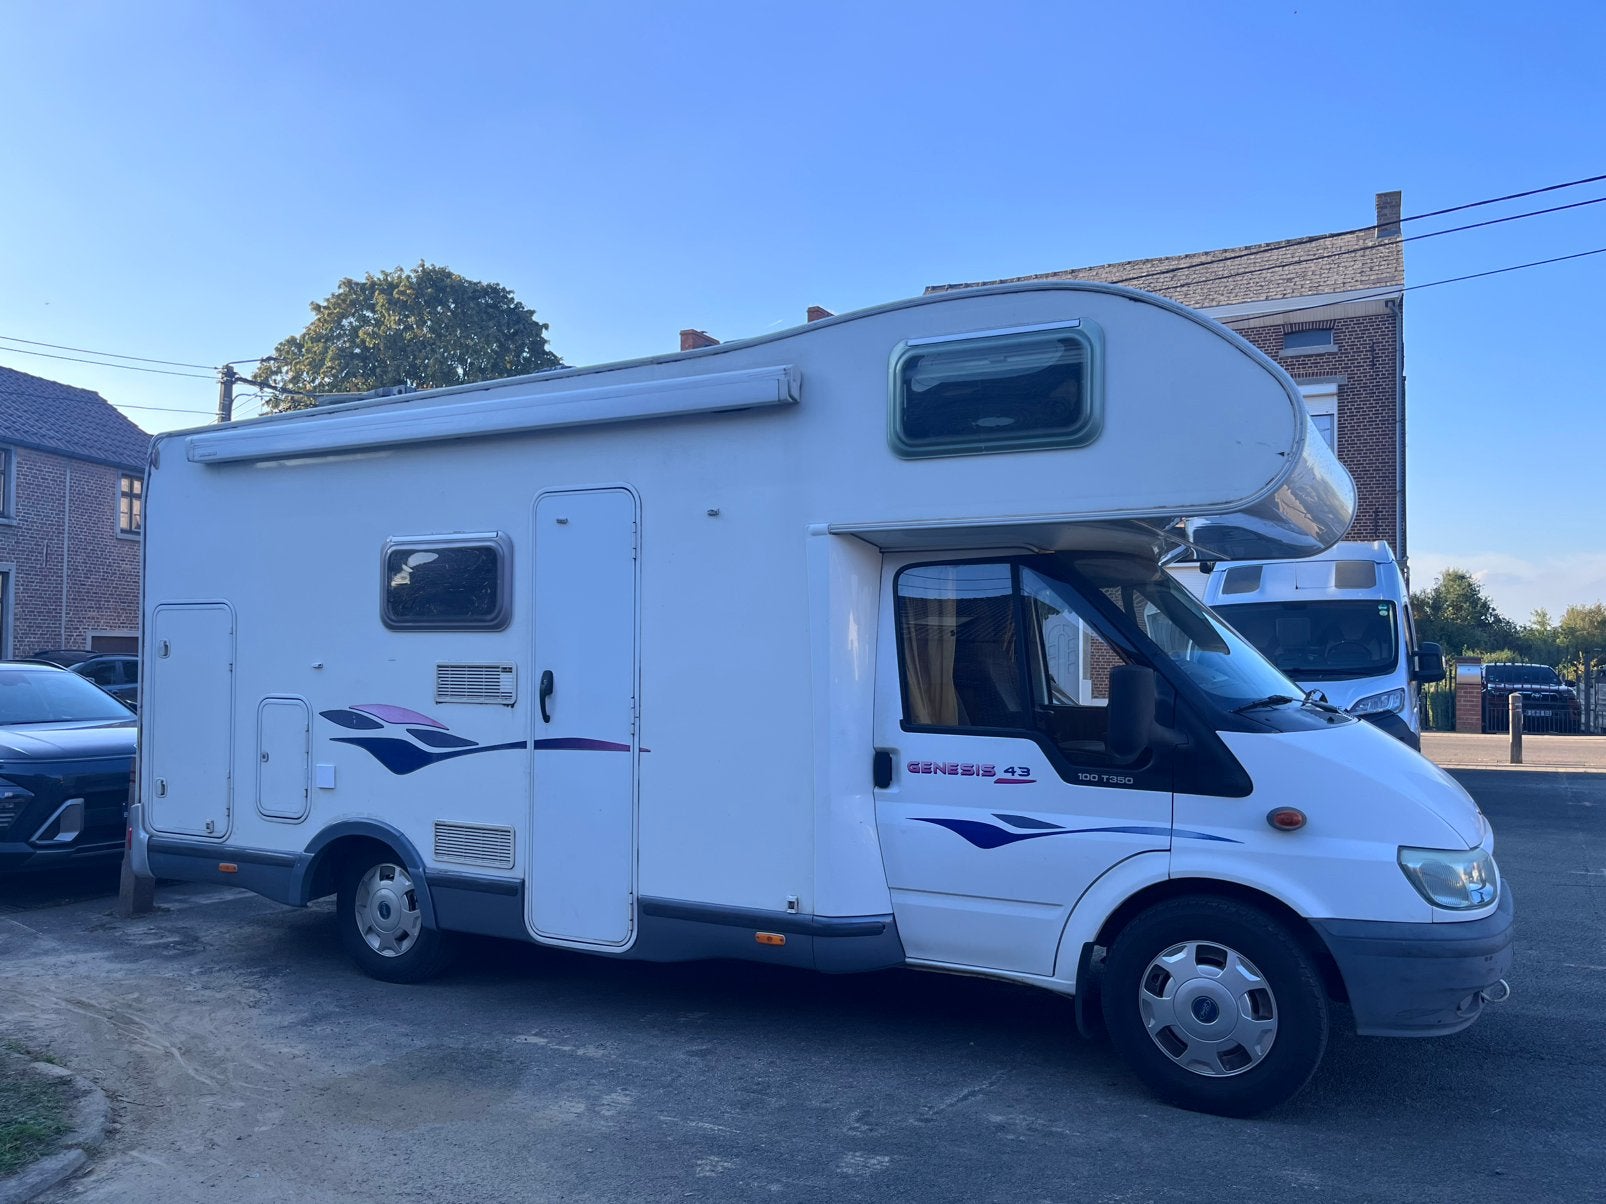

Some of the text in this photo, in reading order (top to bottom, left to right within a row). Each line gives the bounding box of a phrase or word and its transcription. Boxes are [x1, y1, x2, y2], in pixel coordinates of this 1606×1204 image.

[907, 761, 1031, 777] GENESIS 43
[1078, 773, 1134, 784] 100 T350
